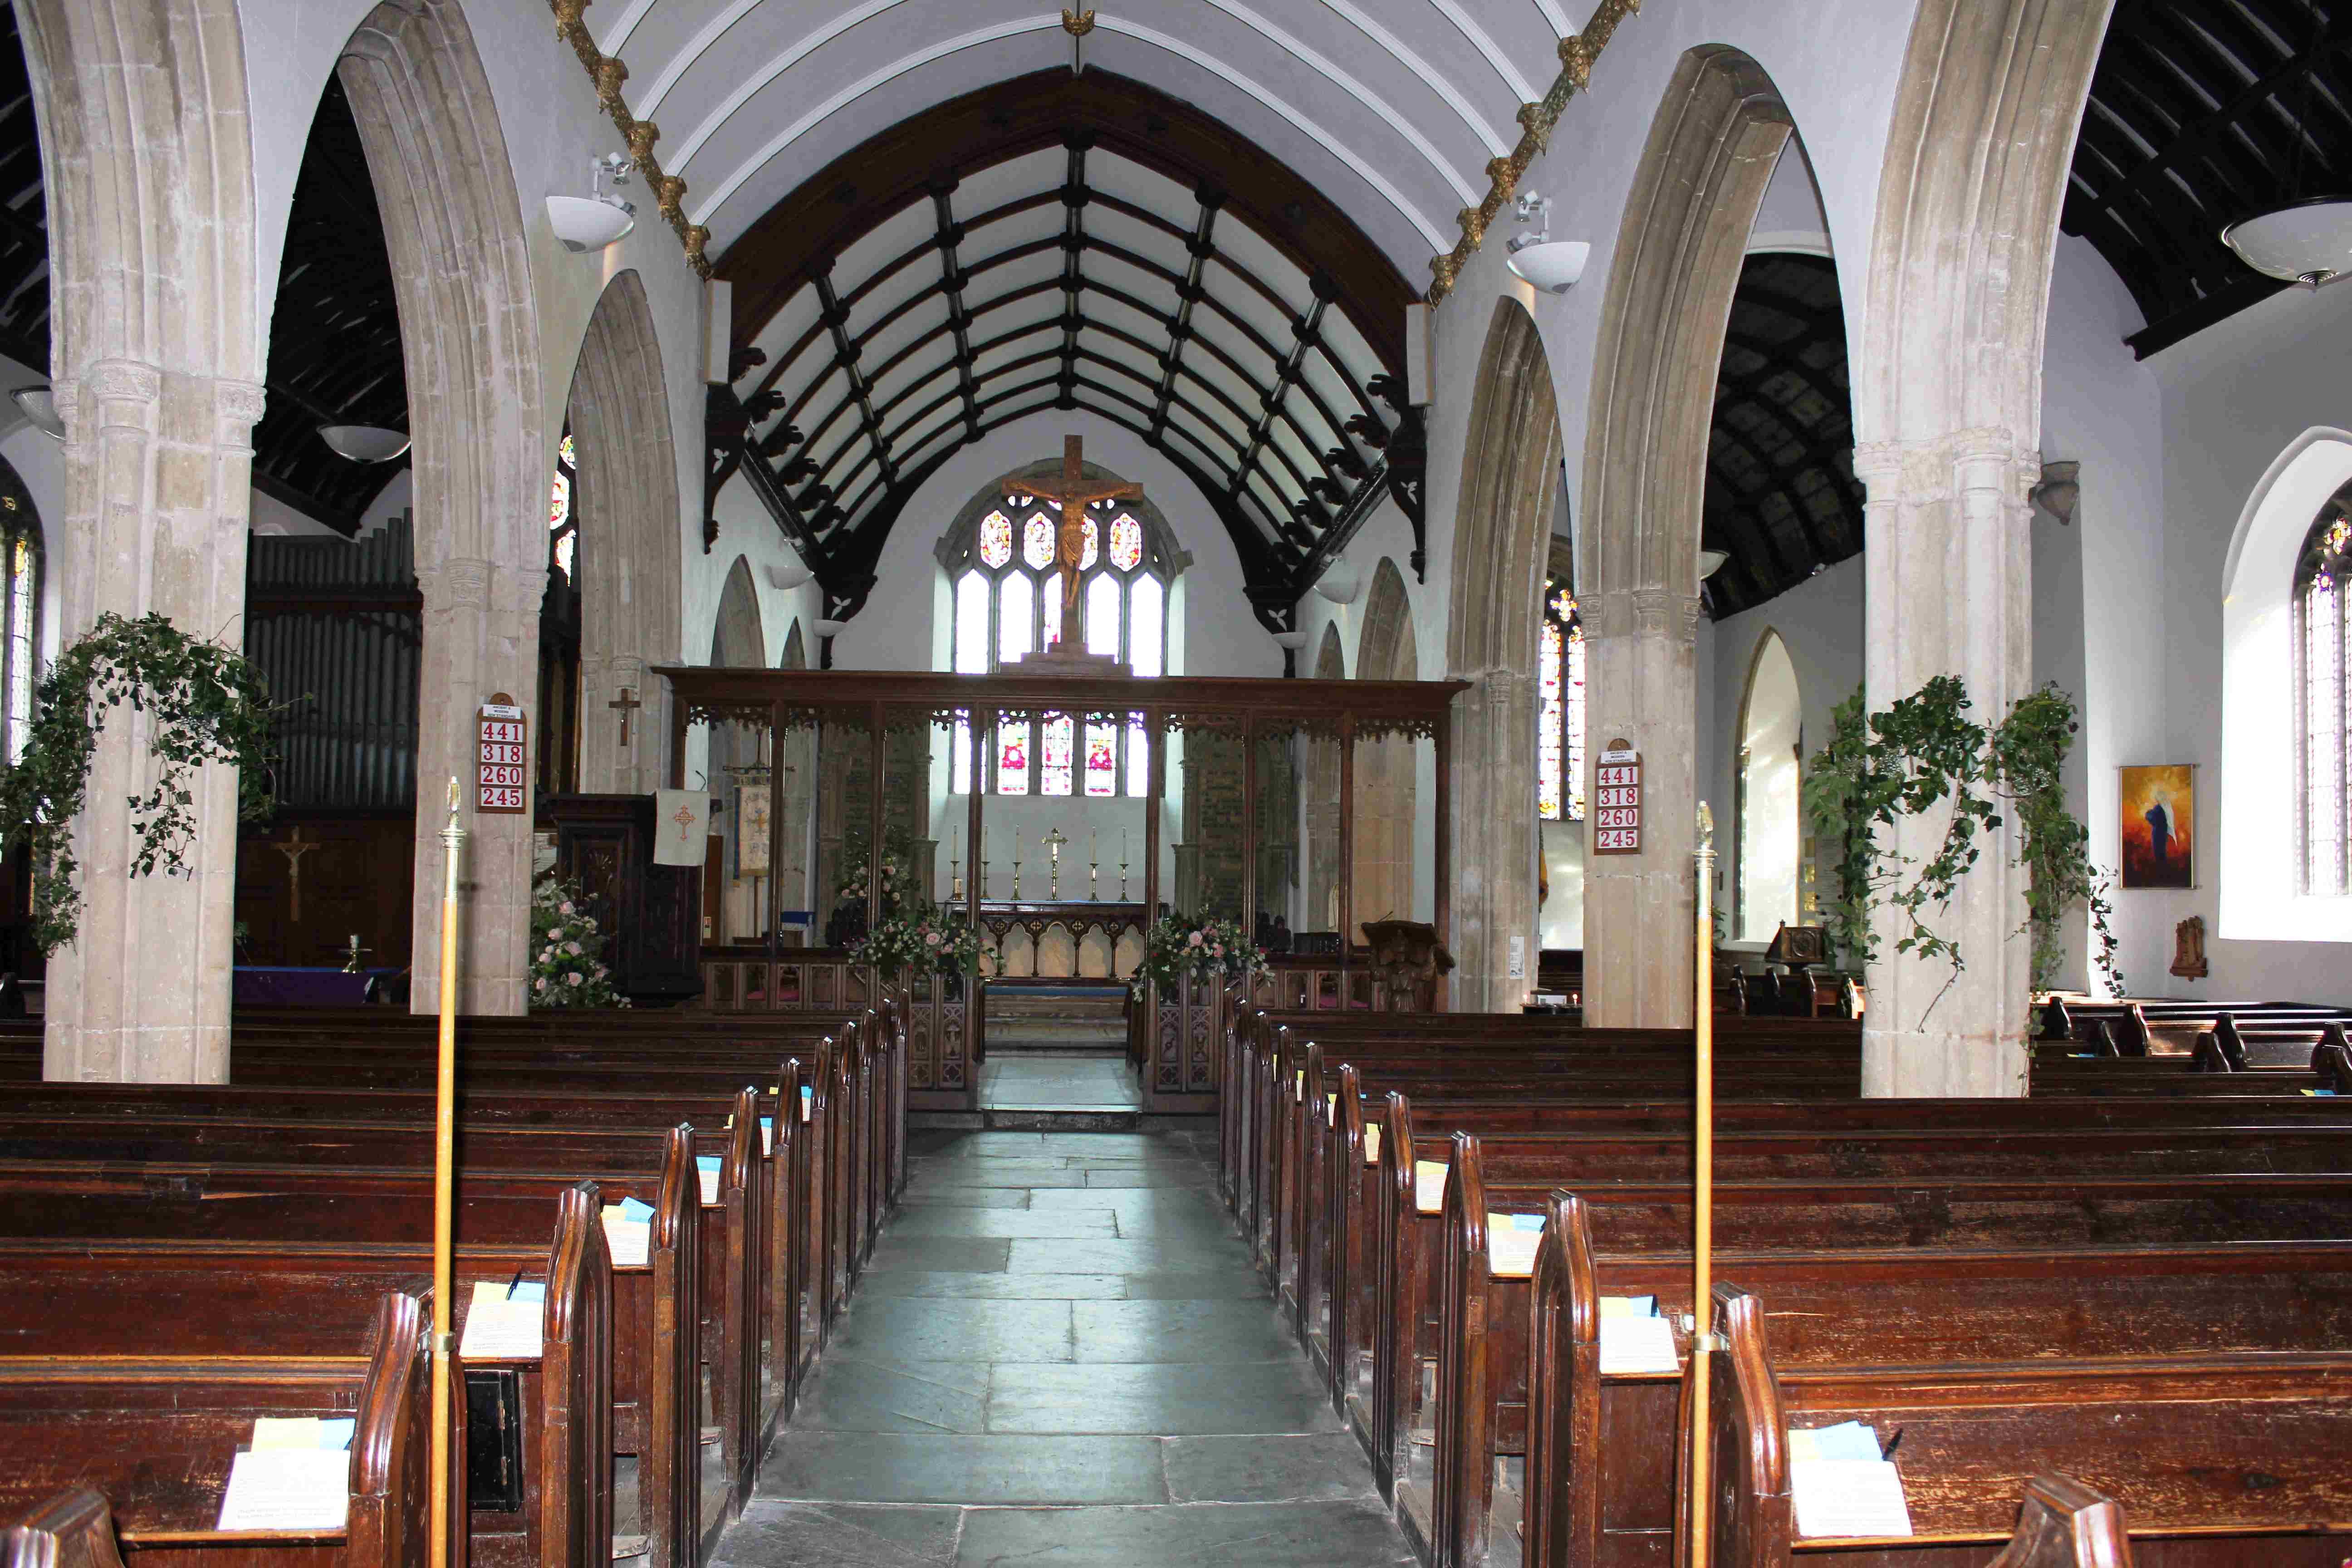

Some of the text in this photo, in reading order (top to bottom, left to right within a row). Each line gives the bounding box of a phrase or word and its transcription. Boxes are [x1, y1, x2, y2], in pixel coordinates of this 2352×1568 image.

[484, 723, 519, 740] 441
[484, 744, 520, 762] 318
[483, 766, 520, 784] 260
[1601, 768, 1634, 784] 441
[483, 789, 520, 805] 245
[1601, 789, 1635, 805] 318
[1601, 809, 1635, 826] 260
[1601, 831, 1635, 847] 245
